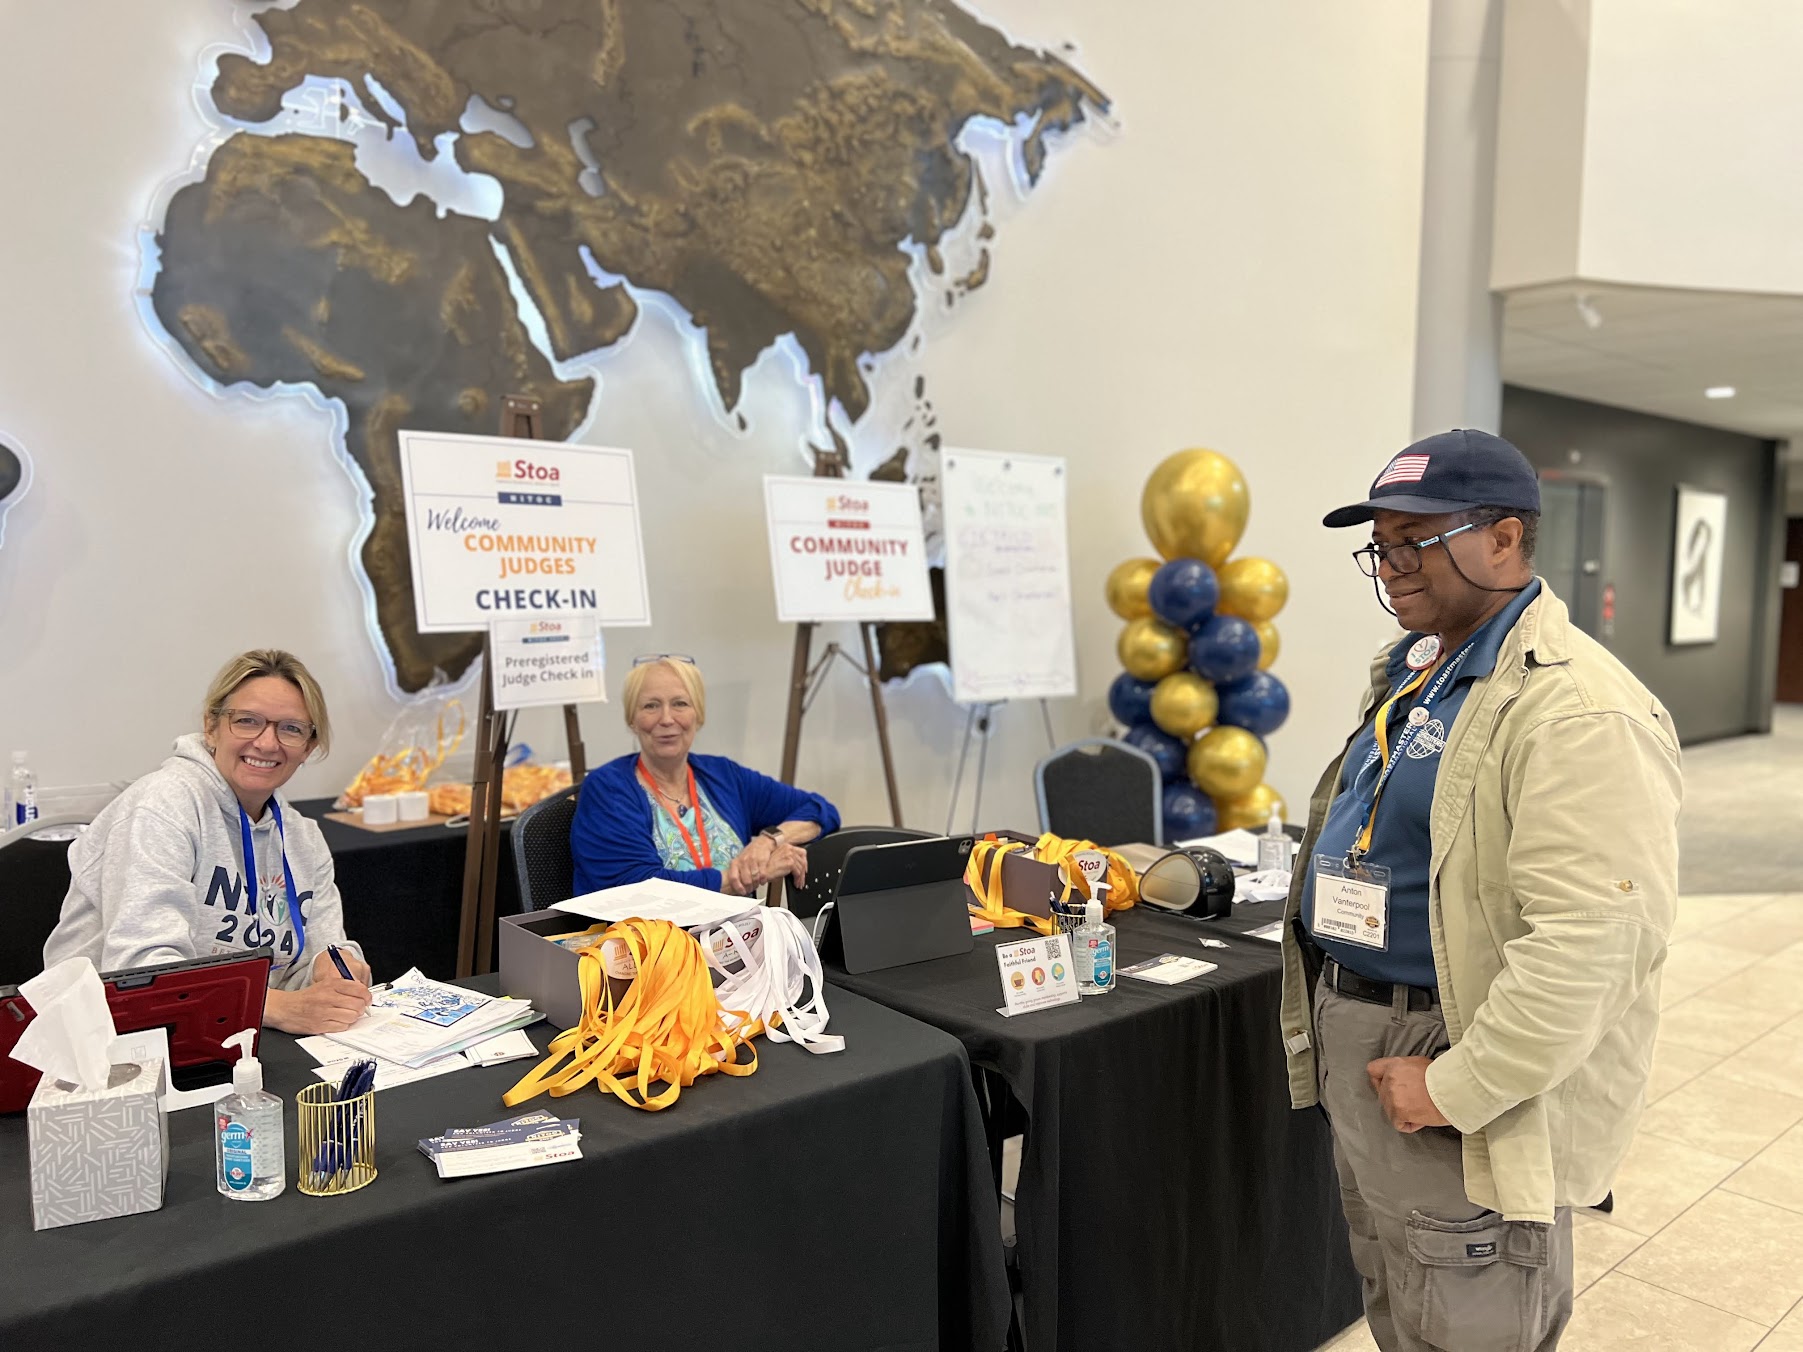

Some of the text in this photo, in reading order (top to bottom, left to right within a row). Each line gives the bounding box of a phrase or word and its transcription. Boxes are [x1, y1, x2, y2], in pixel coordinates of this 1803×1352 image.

[514, 459, 560, 480] Stoa
[427, 506, 500, 533] Welcome
[464, 533, 597, 554] COMMUNITY
[790, 535, 908, 556] COMMUNITY
[499, 557, 576, 579] JUDGES
[825, 560, 882, 581] JUDGE
[475, 589, 598, 610] CHECK-IN
[538, 621, 562, 632] Stoa
[505, 652, 589, 669] Preregistered
[502, 667, 594, 688] Judge Check in
[1079, 860, 1101, 871] Stoa
[1341, 885, 1362, 896] Anton
[1332, 896, 1370, 910] Vanterpool
[1336, 908, 1364, 920] Community
[725, 927, 760, 949] Soa
[1362, 930, 1380, 939] C2201
[1019, 947, 1036, 956] Stoa
[1022, 956, 1036, 964] Friend
[545, 1151, 575, 1159] Stoa
